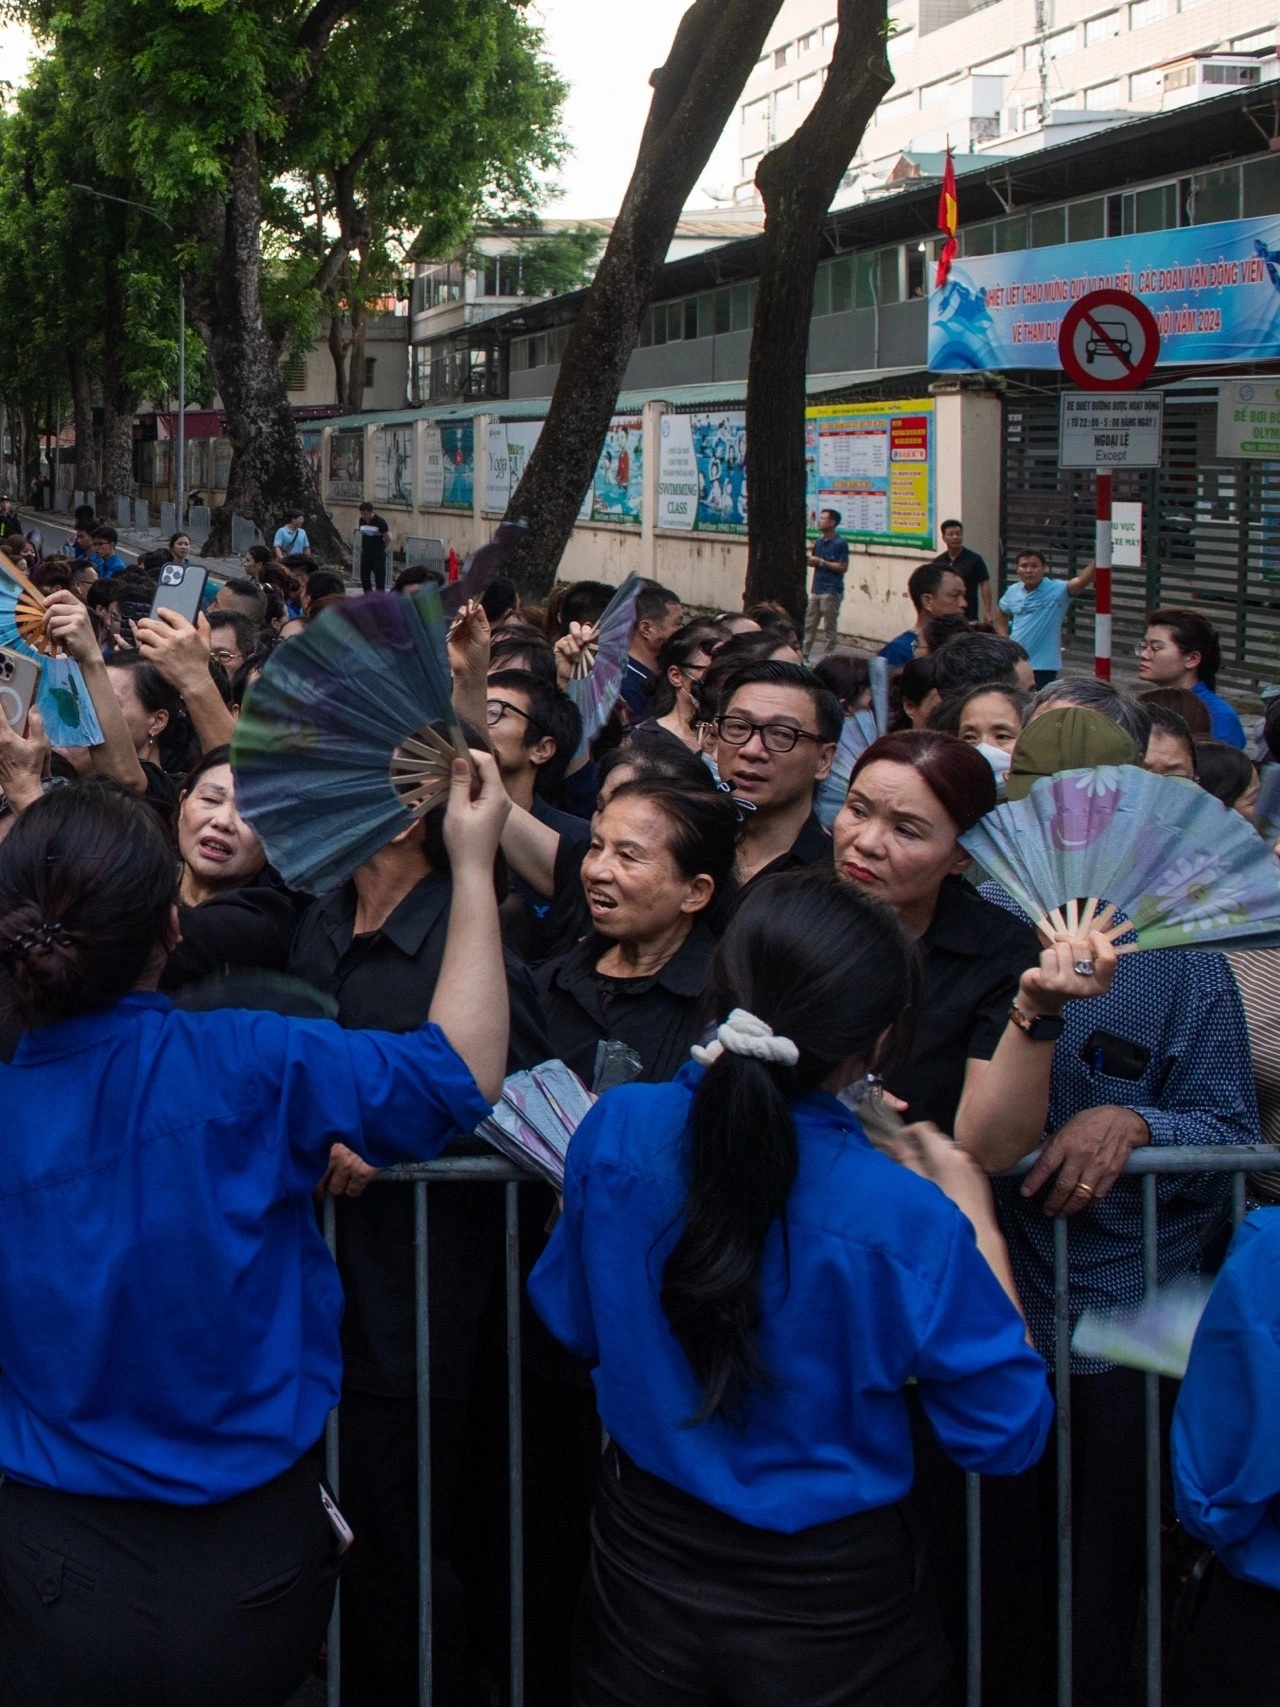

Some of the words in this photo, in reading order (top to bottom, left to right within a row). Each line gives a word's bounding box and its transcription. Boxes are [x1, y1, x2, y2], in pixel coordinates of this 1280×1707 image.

[1139, 264, 1157, 293] CÁC
[1159, 261, 1185, 291] ĐOÀN
[1189, 258, 1209, 297] VẬN
[1210, 255, 1238, 295] ĐỘNG
[1241, 252, 1265, 283] VIÊN
[1175, 303, 1196, 334] NĂM
[1198, 308, 1221, 332] 2024
[1024, 322, 1045, 342] THAM
[1094, 434, 1118, 448] NGOẠI
[1120, 432, 1129, 448] LỆ
[1096, 449, 1126, 463] Except
[488, 452, 507, 480] Yoga
[659, 483, 697, 496] SWIMMING
[667, 501, 688, 514] CLASS
